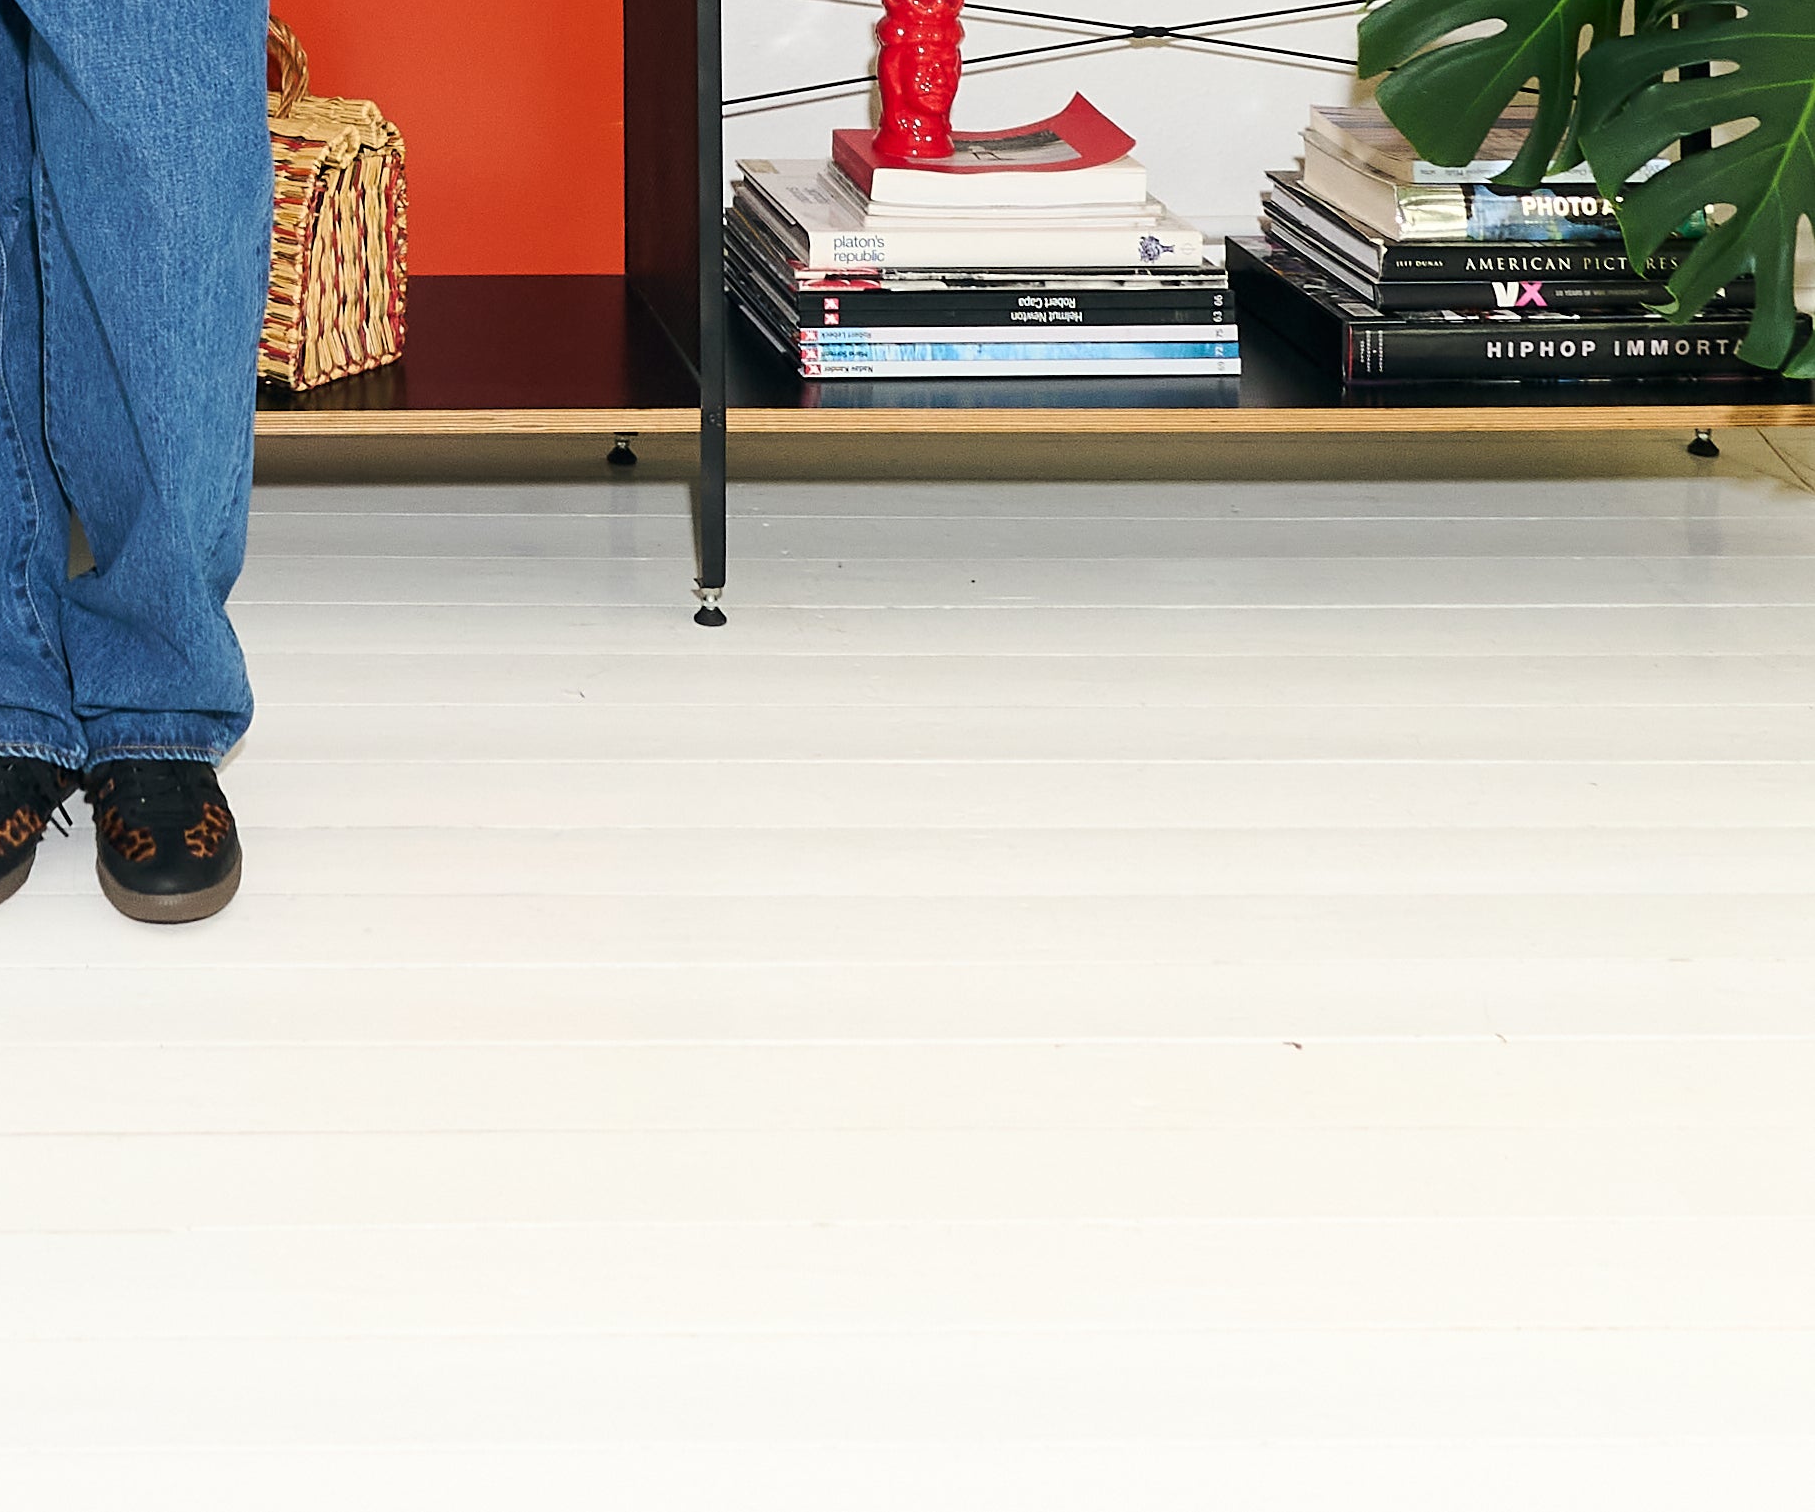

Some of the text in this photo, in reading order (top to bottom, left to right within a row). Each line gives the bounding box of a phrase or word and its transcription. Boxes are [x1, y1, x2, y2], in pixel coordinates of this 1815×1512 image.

[1520, 196, 1598, 217] PHOTO
[833, 235, 885, 250] platon's
[833, 249, 885, 264] republic
[1465, 256, 1679, 271] AMERICAN PICTRES
[1018, 295, 1076, 309] Robert Capa
[1010, 311, 1083, 323] Helmut Newton
[1487, 340, 1597, 358] HIPHOP
